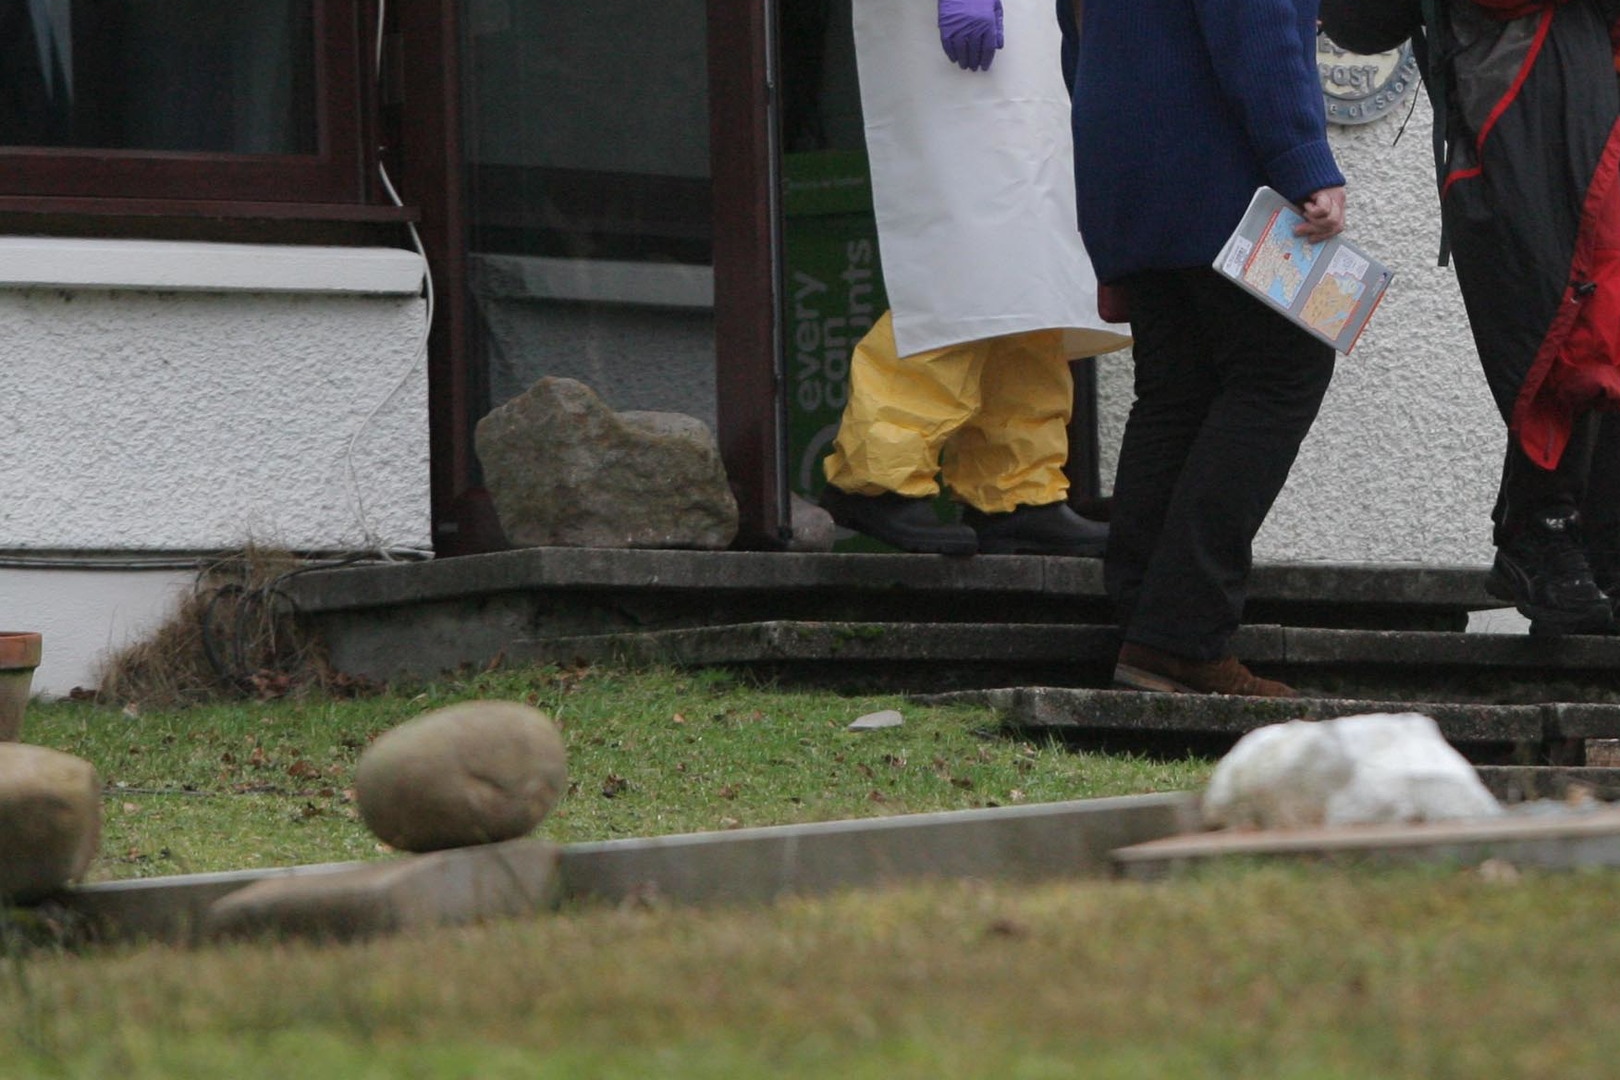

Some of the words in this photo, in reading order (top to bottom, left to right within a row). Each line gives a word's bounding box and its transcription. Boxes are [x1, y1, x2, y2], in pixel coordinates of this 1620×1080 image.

[1319, 64, 1379, 93] POST
[1375, 56, 1417, 110] Scotla
[842, 239, 873, 345] unts
[793, 271, 828, 412] every
[823, 317, 850, 408] can
